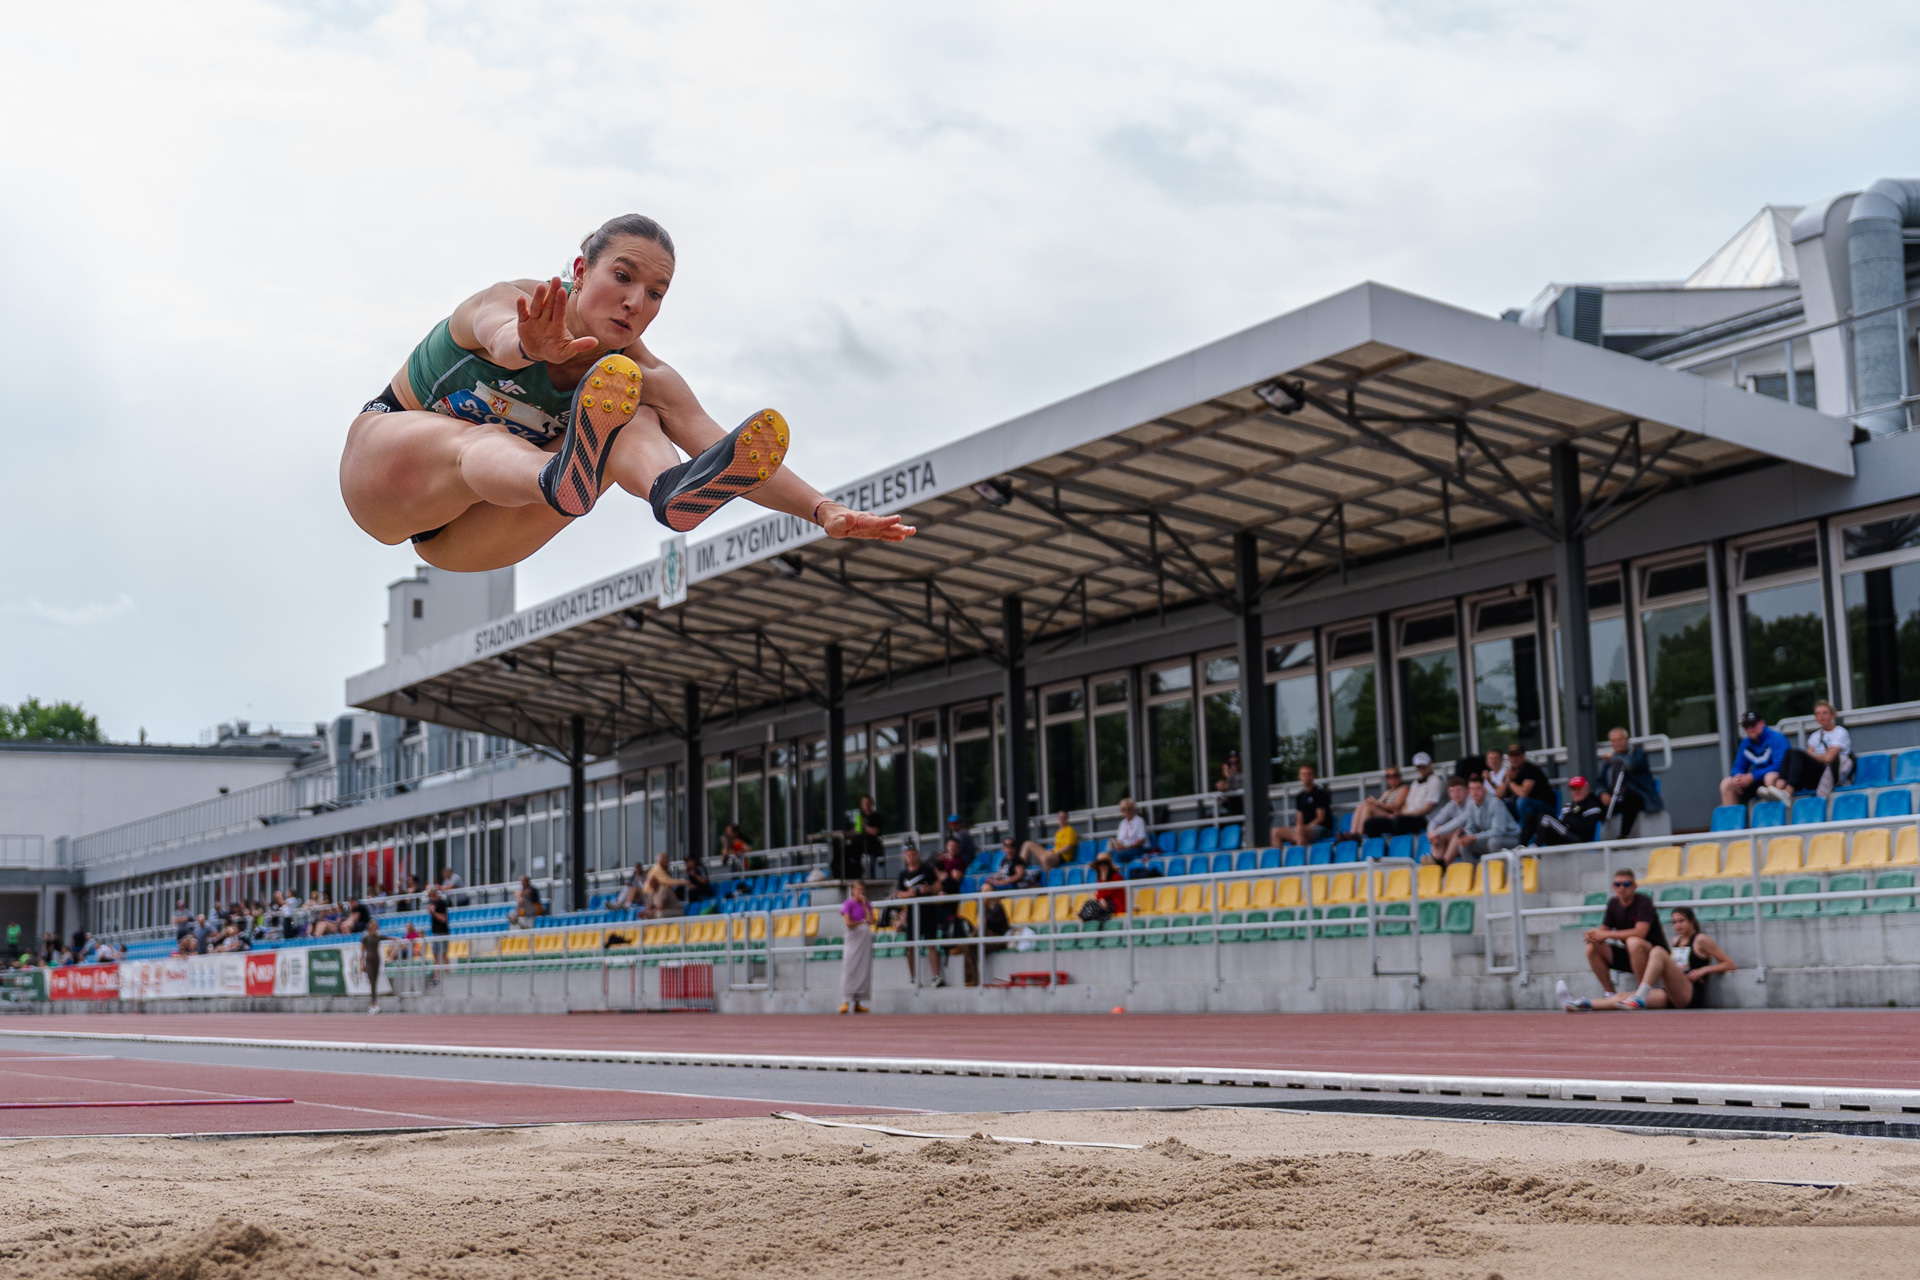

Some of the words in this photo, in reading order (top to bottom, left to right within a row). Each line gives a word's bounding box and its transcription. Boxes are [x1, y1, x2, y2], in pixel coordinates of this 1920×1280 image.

[475, 614, 525, 653] STADION
[529, 567, 656, 634] LEKKOATLETYCZNY
[696, 543, 720, 573] IM.
[726, 512, 819, 562] ZYGMUN
